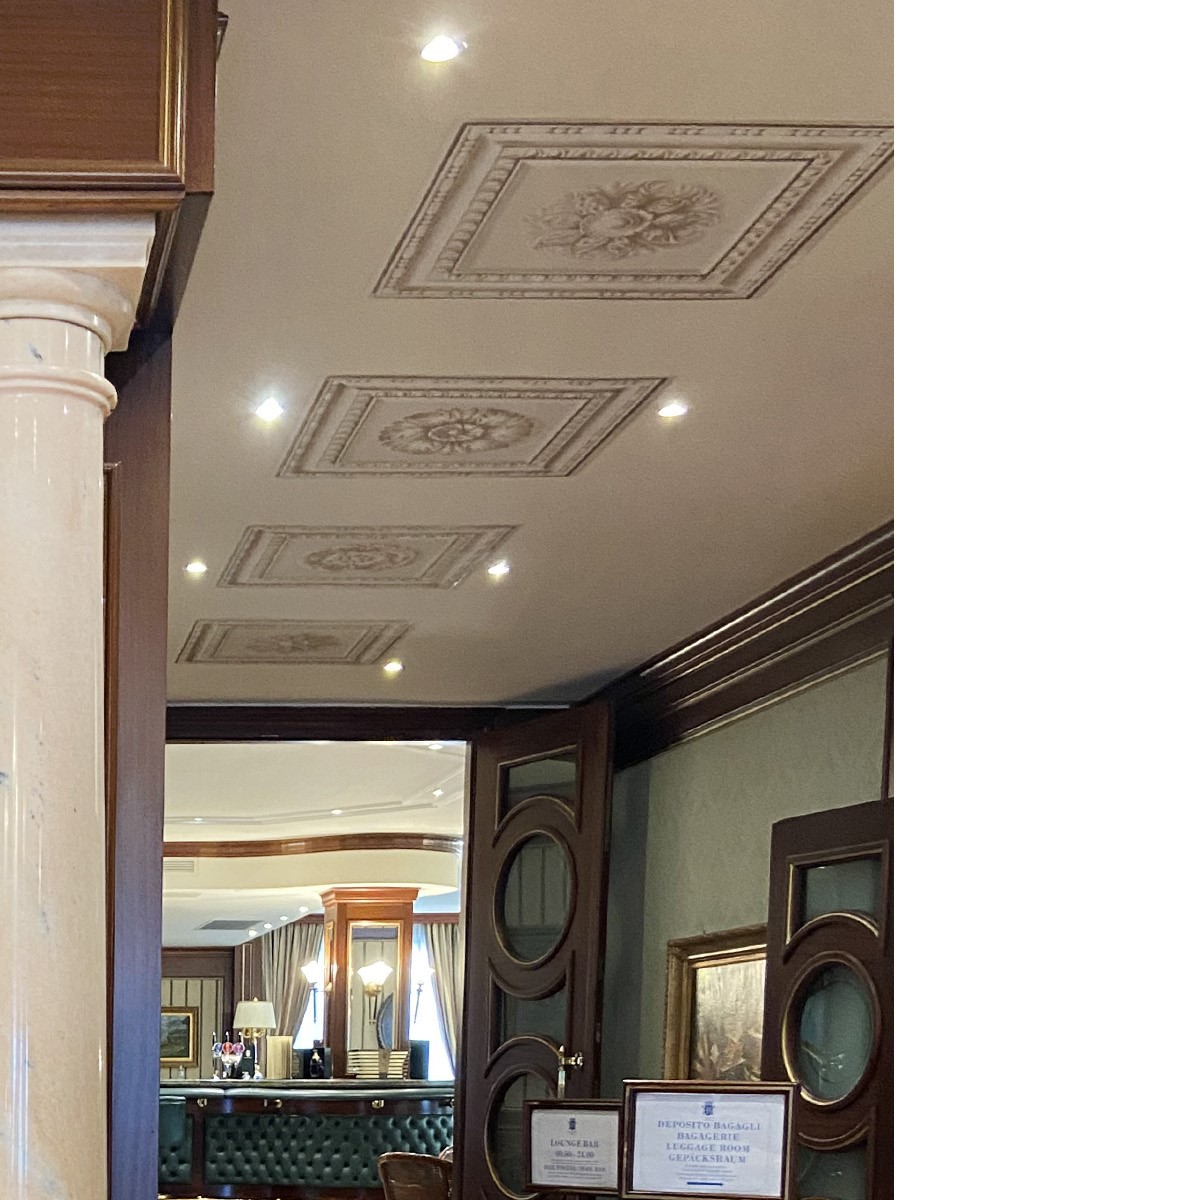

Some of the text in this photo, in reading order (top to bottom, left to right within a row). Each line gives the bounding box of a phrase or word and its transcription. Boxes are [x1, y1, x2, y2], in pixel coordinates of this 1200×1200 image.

[657, 1120, 761, 1131] DEPOSITO BAGAGLI
[677, 1132, 740, 1141] BAGAGERIE
[550, 1139, 599, 1148] LOUNGE BAR
[666, 1142, 750, 1153] LUGGAGE ROOM
